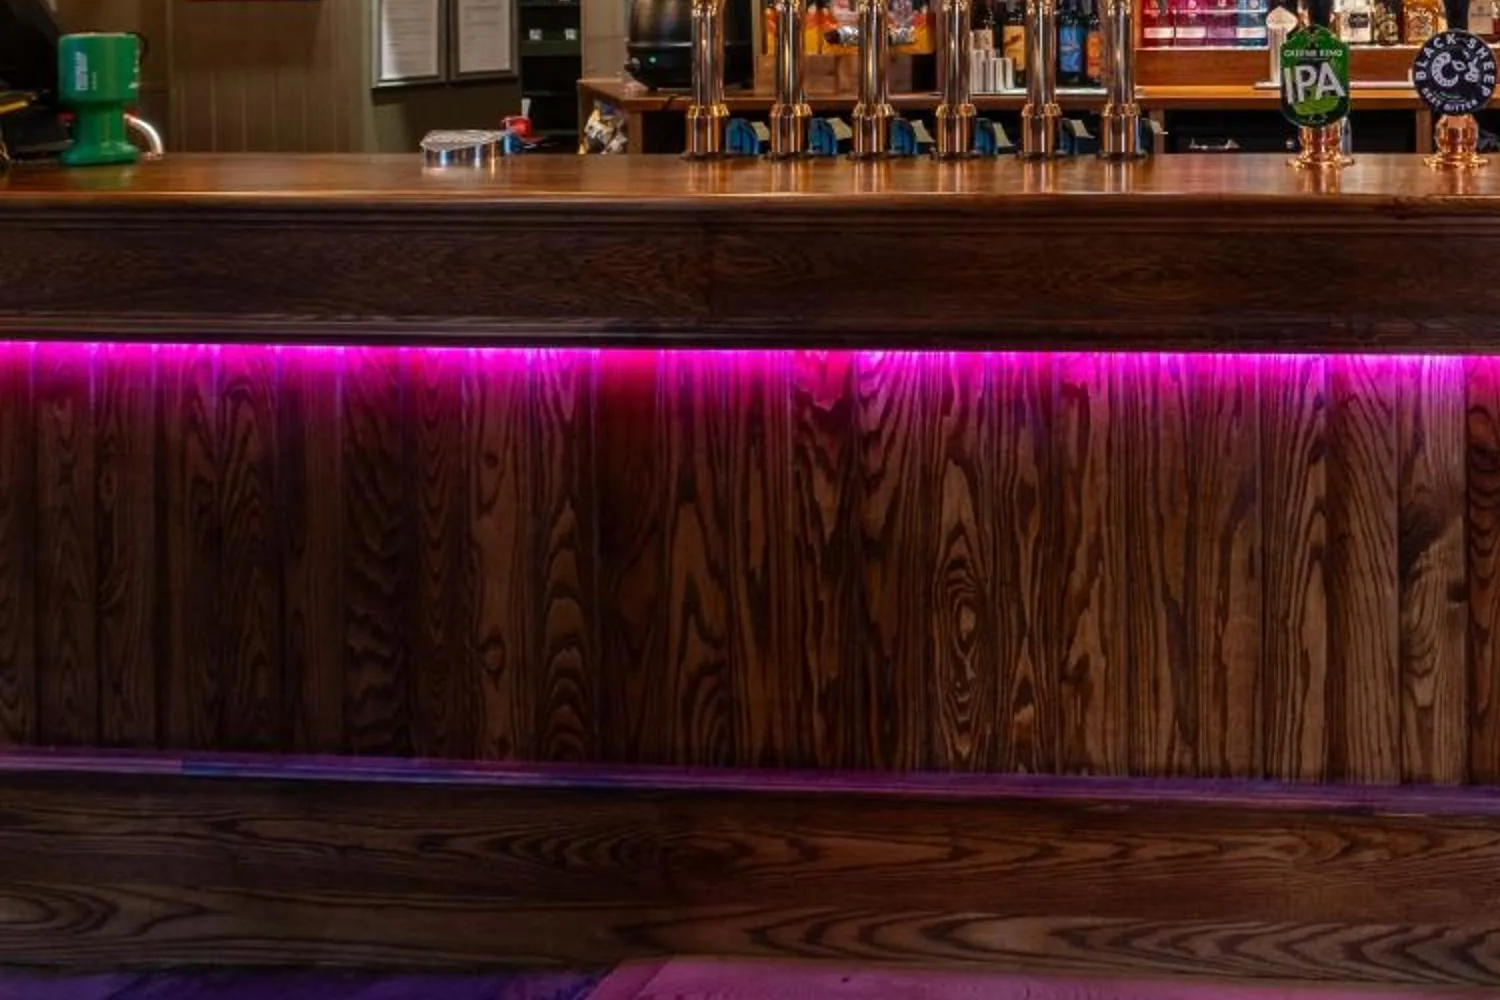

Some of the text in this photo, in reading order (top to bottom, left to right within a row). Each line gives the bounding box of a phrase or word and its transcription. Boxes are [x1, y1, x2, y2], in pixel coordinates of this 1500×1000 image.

[1284, 62, 1346, 104] IPA
[1416, 33, 1495, 97] BLACK SHEEP
